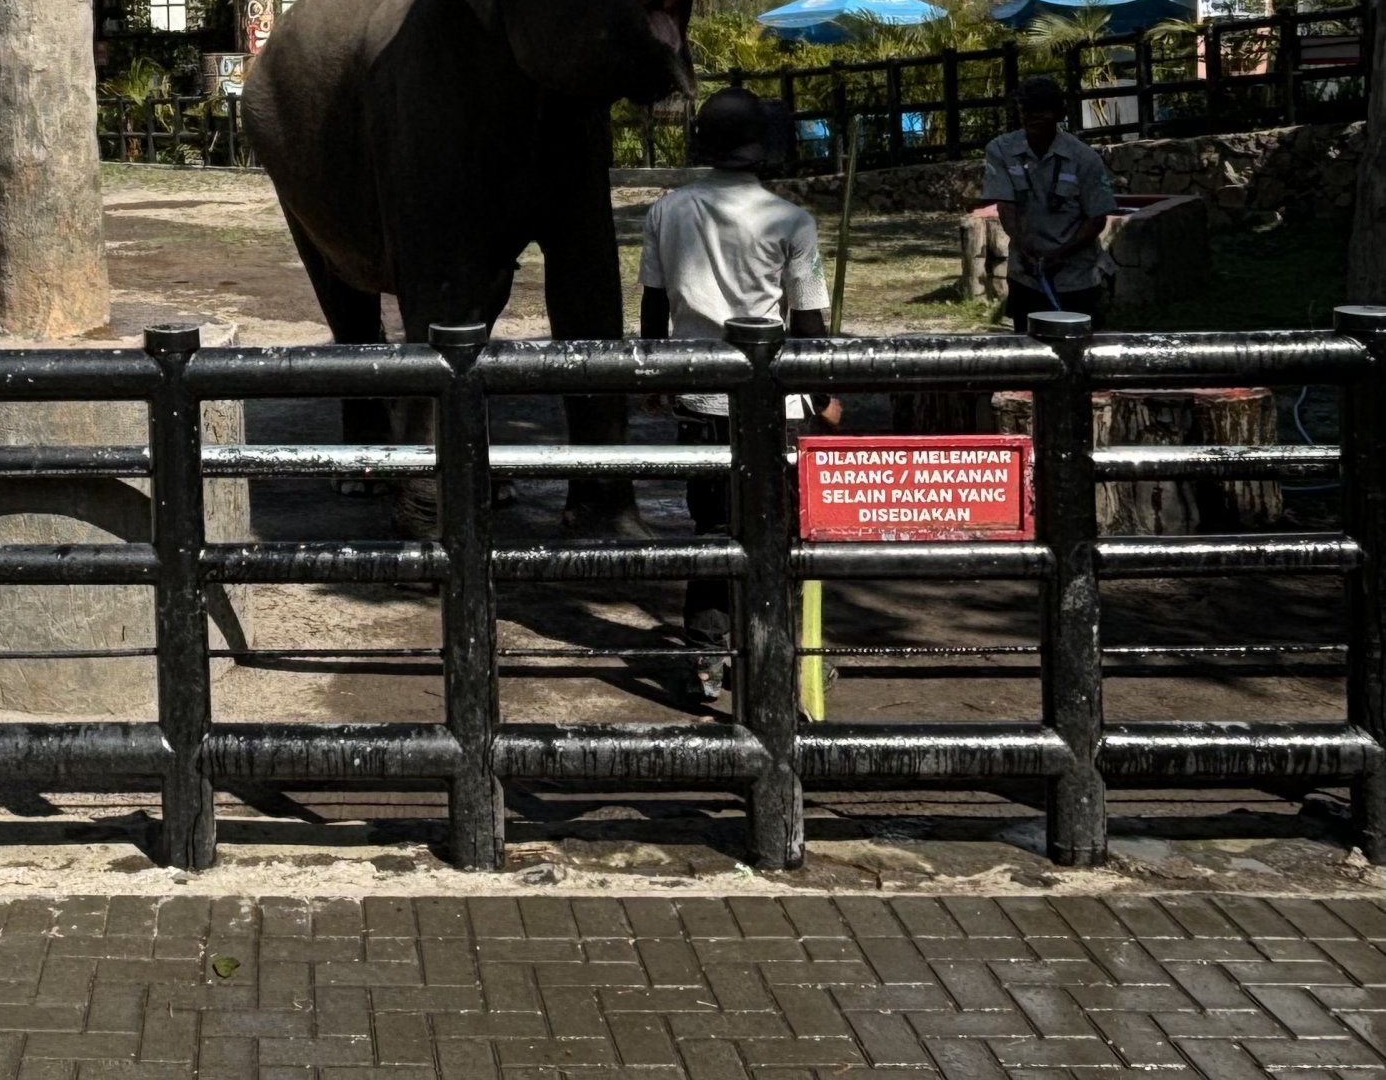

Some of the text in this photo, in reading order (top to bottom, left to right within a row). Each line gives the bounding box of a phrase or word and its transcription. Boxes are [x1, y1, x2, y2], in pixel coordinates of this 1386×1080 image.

[815, 450, 1012, 466] DILARANG MELEMPAR
[819, 469, 1008, 485] BARANG / MAKANAN
[822, 488, 1006, 504] SELAIN PAKAN YANG
[858, 508, 971, 523] DISEDIAKAN
